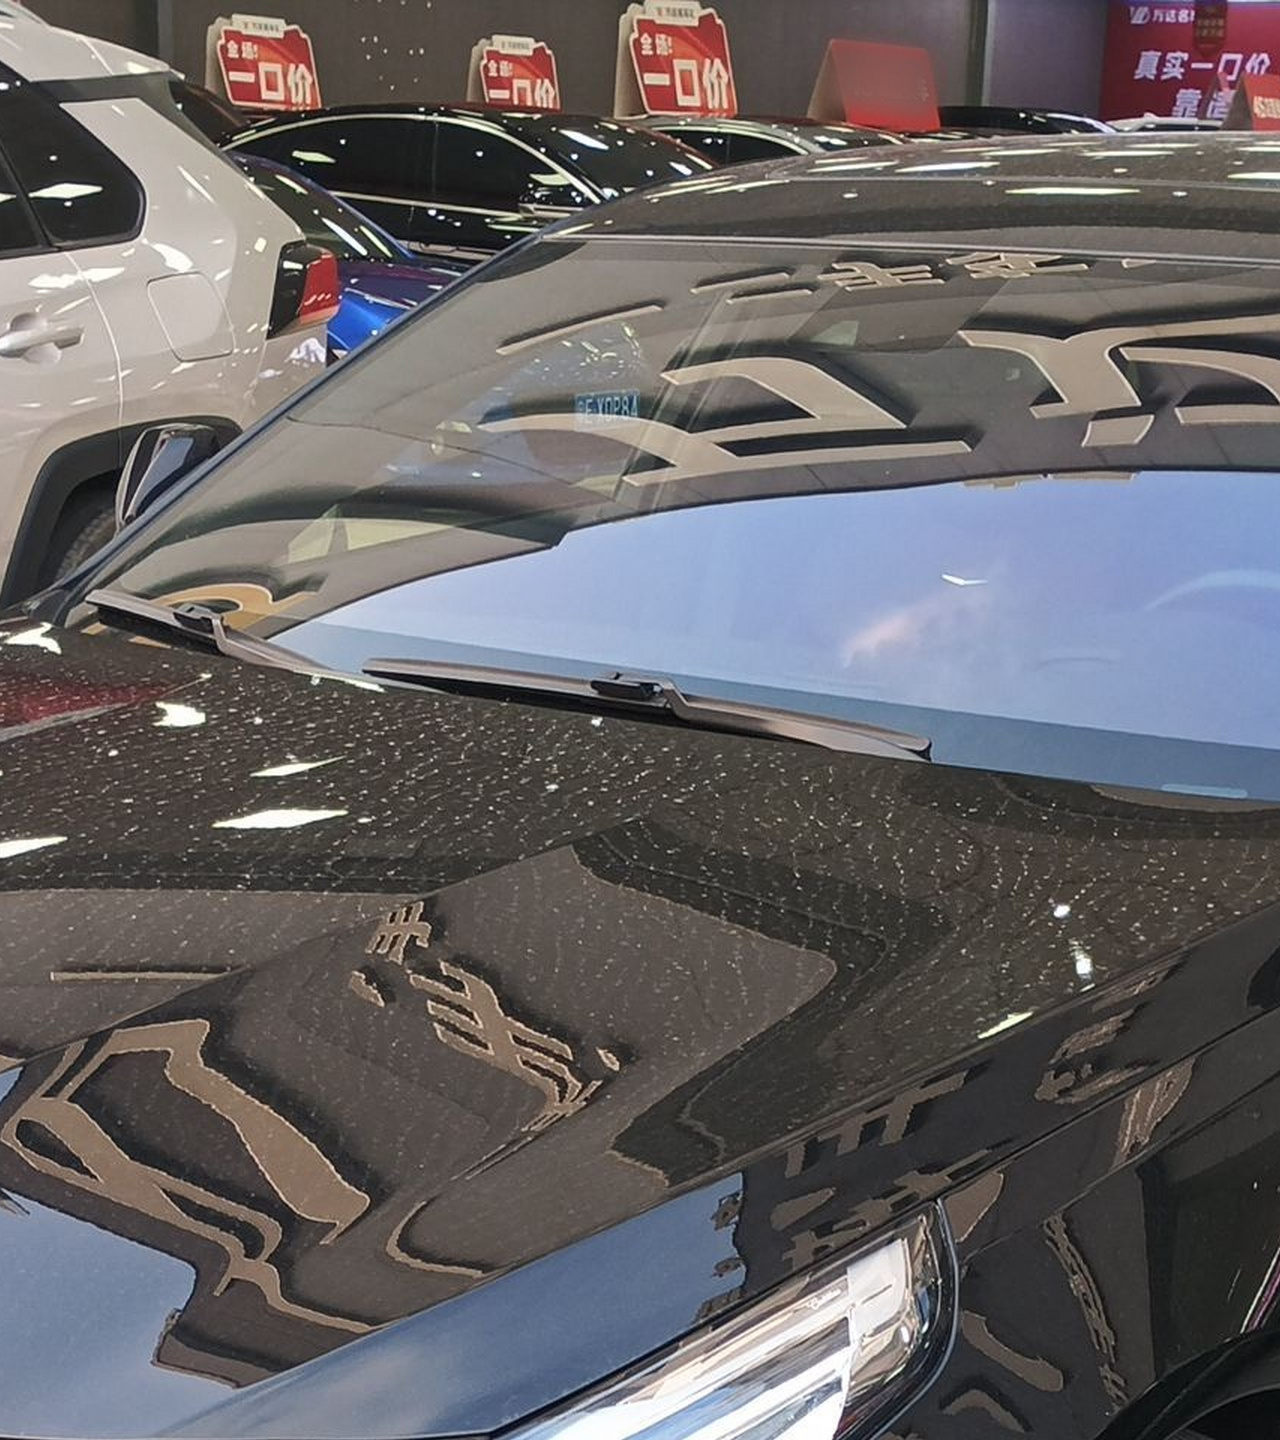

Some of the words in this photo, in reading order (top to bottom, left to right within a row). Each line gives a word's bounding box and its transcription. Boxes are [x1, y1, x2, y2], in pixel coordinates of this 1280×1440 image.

[228, 62, 313, 104] 一口价
[489, 78, 555, 109] 一口价
[643, 58, 730, 109] 一口价
